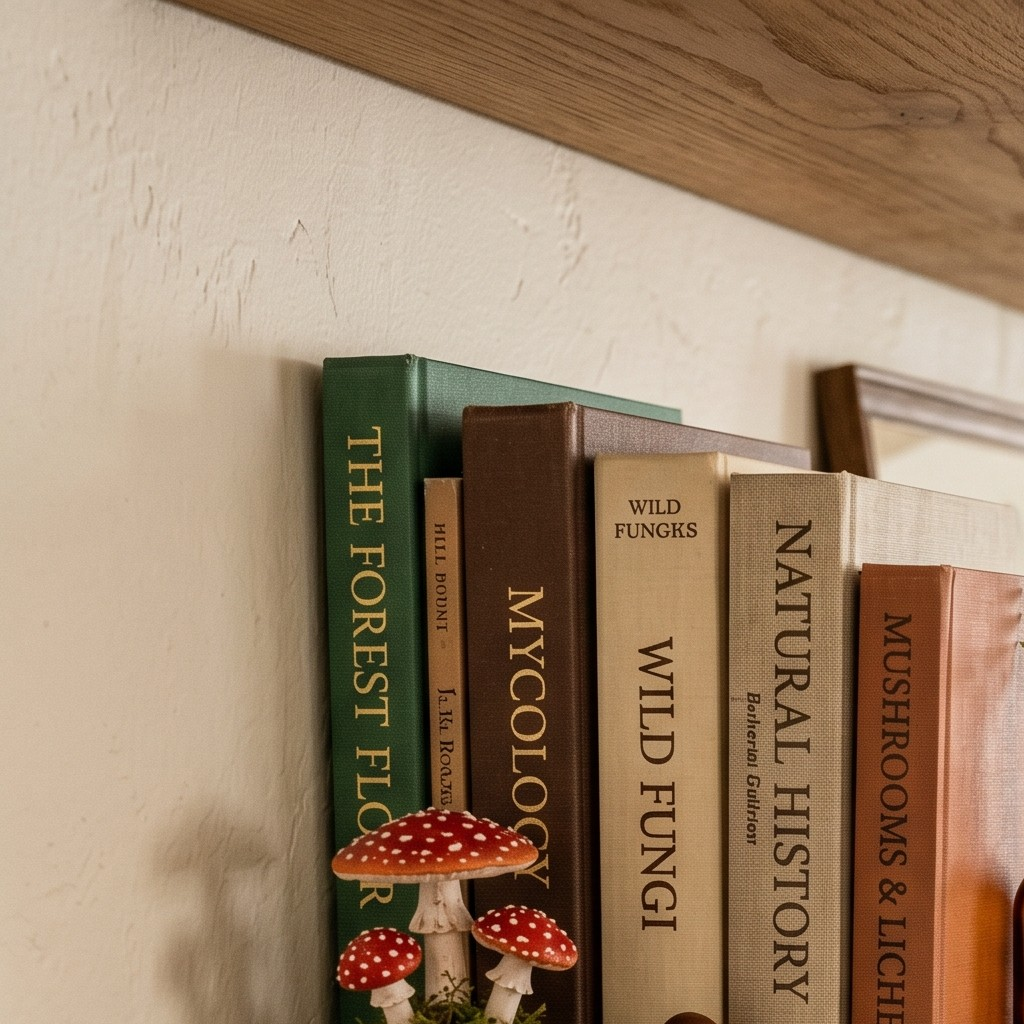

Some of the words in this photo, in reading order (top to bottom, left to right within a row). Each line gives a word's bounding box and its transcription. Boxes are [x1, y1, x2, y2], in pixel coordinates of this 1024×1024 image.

[347, 425, 384, 526] THE
[614, 522, 698, 539] FUNGKS
[628, 499, 681, 515] WILD
[350, 543, 390, 727] FOREST
[637, 636, 676, 766] WILD
[773, 519, 812, 765] NATURAL
[878, 612, 912, 868] MUSHROOMS
[355, 746, 395, 910] FLOR
[638, 781, 678, 931] FUNGI
[772, 783, 810, 1005] HISTORY
[877, 877, 906, 905] &
